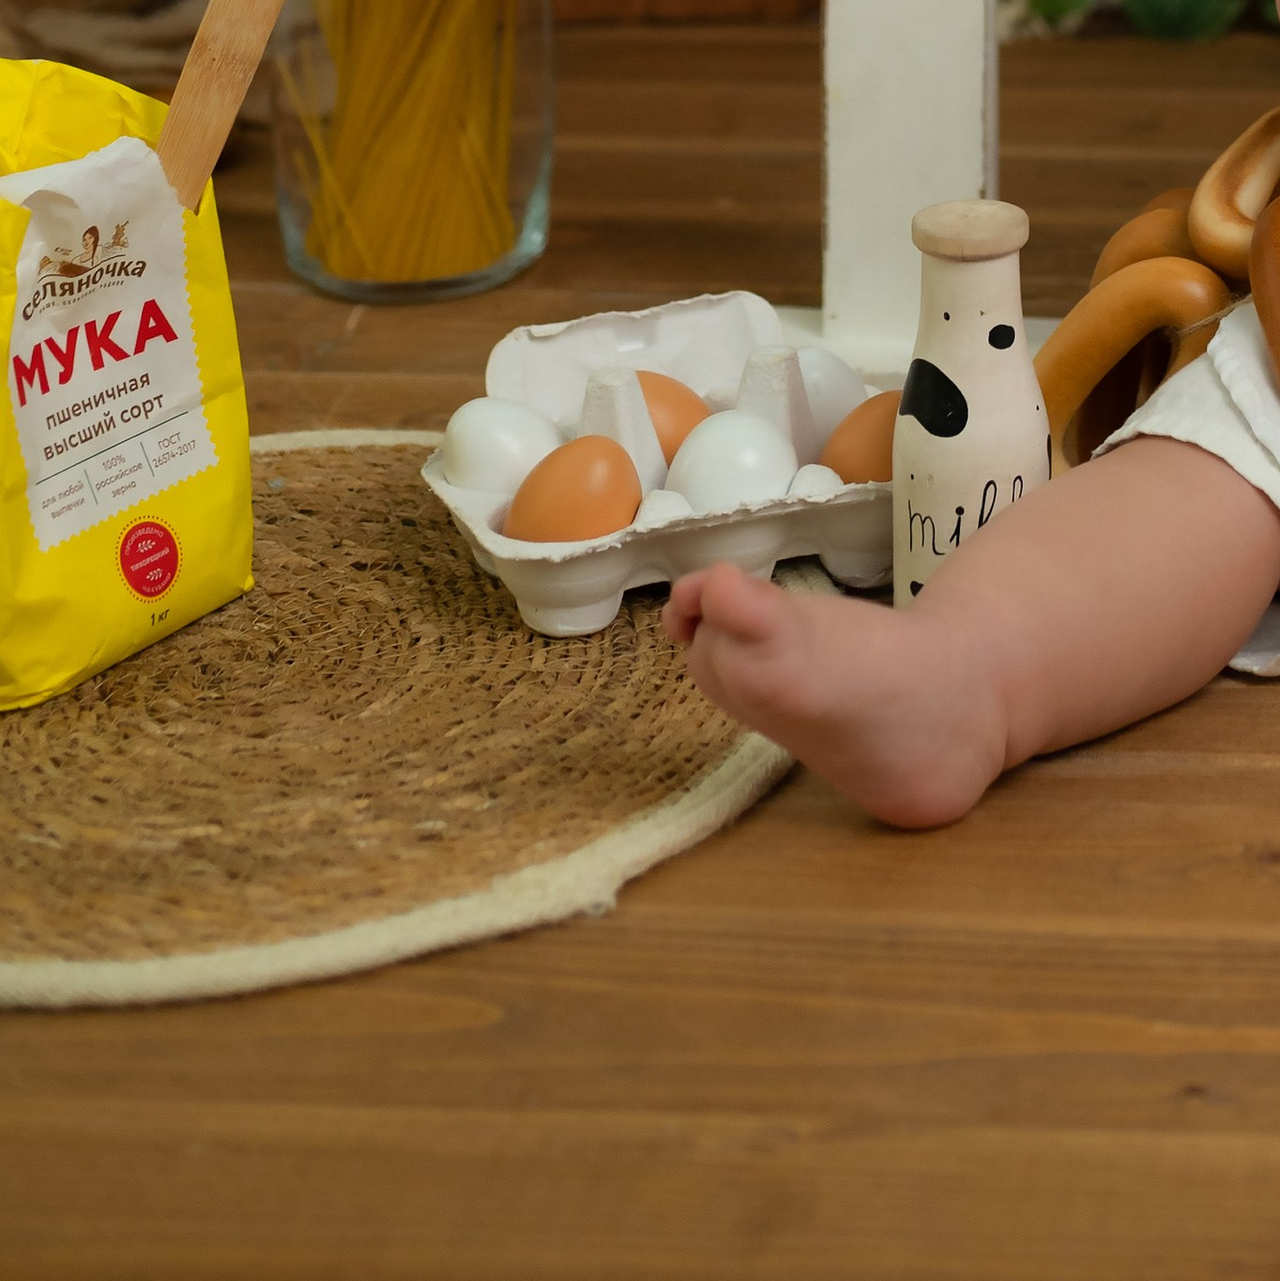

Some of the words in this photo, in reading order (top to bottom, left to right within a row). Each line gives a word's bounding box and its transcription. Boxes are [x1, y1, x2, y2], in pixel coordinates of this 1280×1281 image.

[12, 299, 179, 408] МУКА
[46, 372, 151, 430] пшеничная
[43, 412, 117, 461] высший
[120, 394, 164, 424] сорт
[157, 431, 182, 451] ГОСТ
[102, 454, 126, 471] 100%
[152, 440, 197, 468] 26574-2017
[58, 480, 85, 501] любой
[95, 462, 143, 491] российское
[111, 481, 137, 499] зерно
[908, 475, 1023, 556] mil
[151, 613, 155, 627] 1
[158, 608, 170, 623] кг
